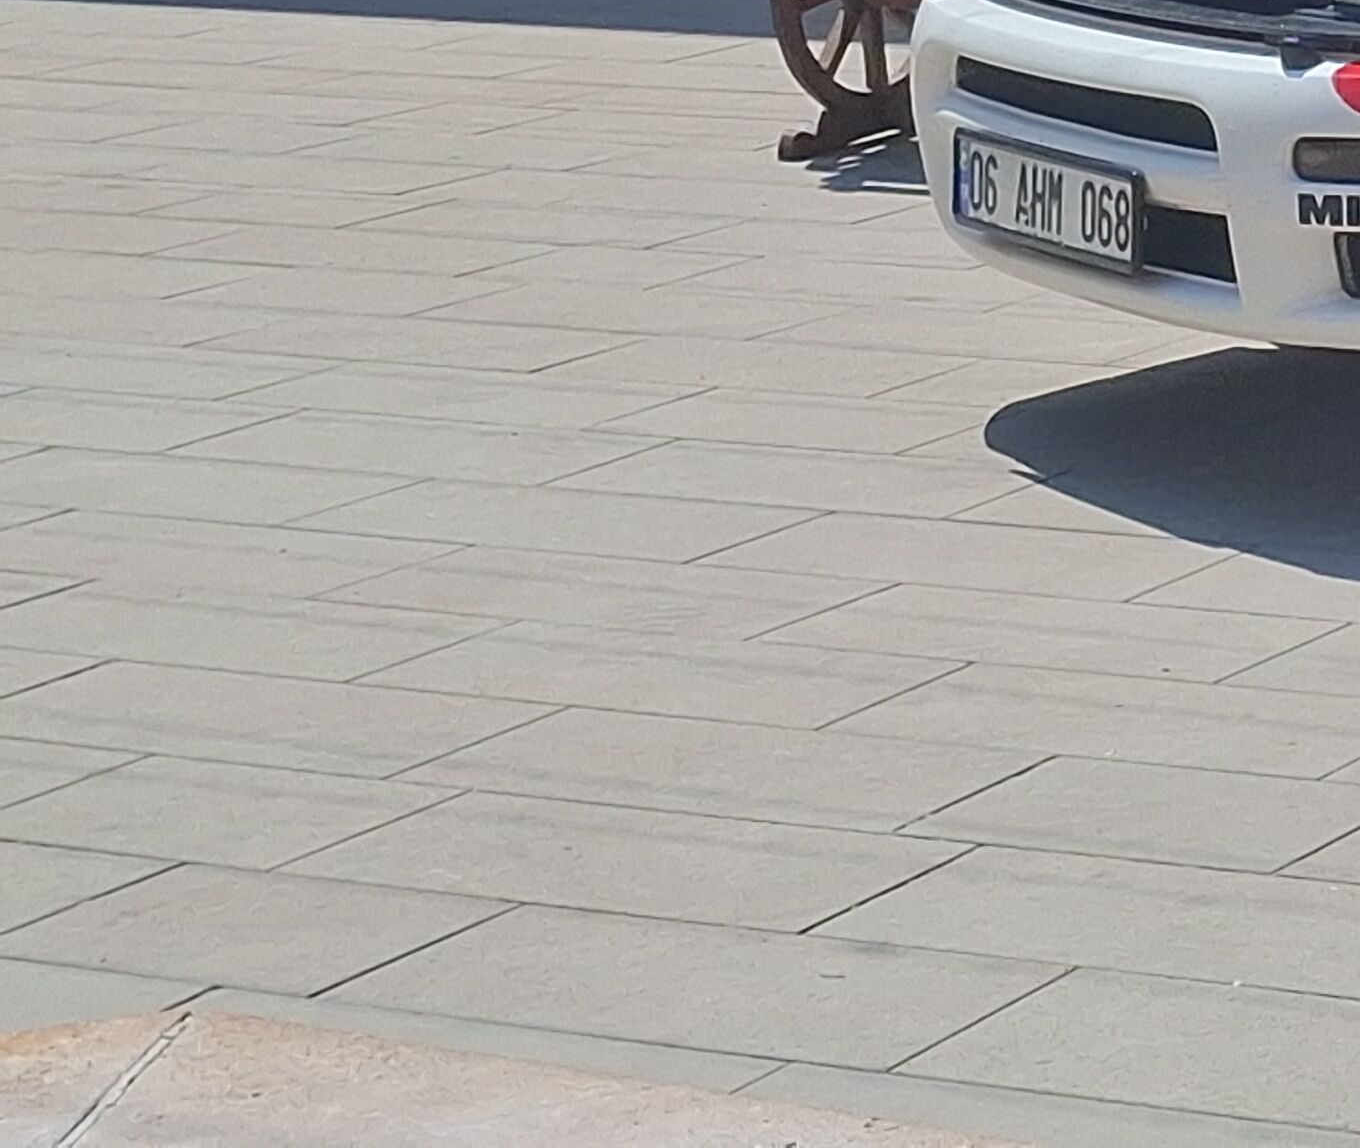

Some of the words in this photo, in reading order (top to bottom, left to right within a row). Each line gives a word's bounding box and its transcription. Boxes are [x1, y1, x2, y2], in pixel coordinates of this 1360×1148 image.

[969, 150, 999, 216] 06
[1014, 160, 1064, 237] AHM
[1080, 179, 1131, 253] 068
